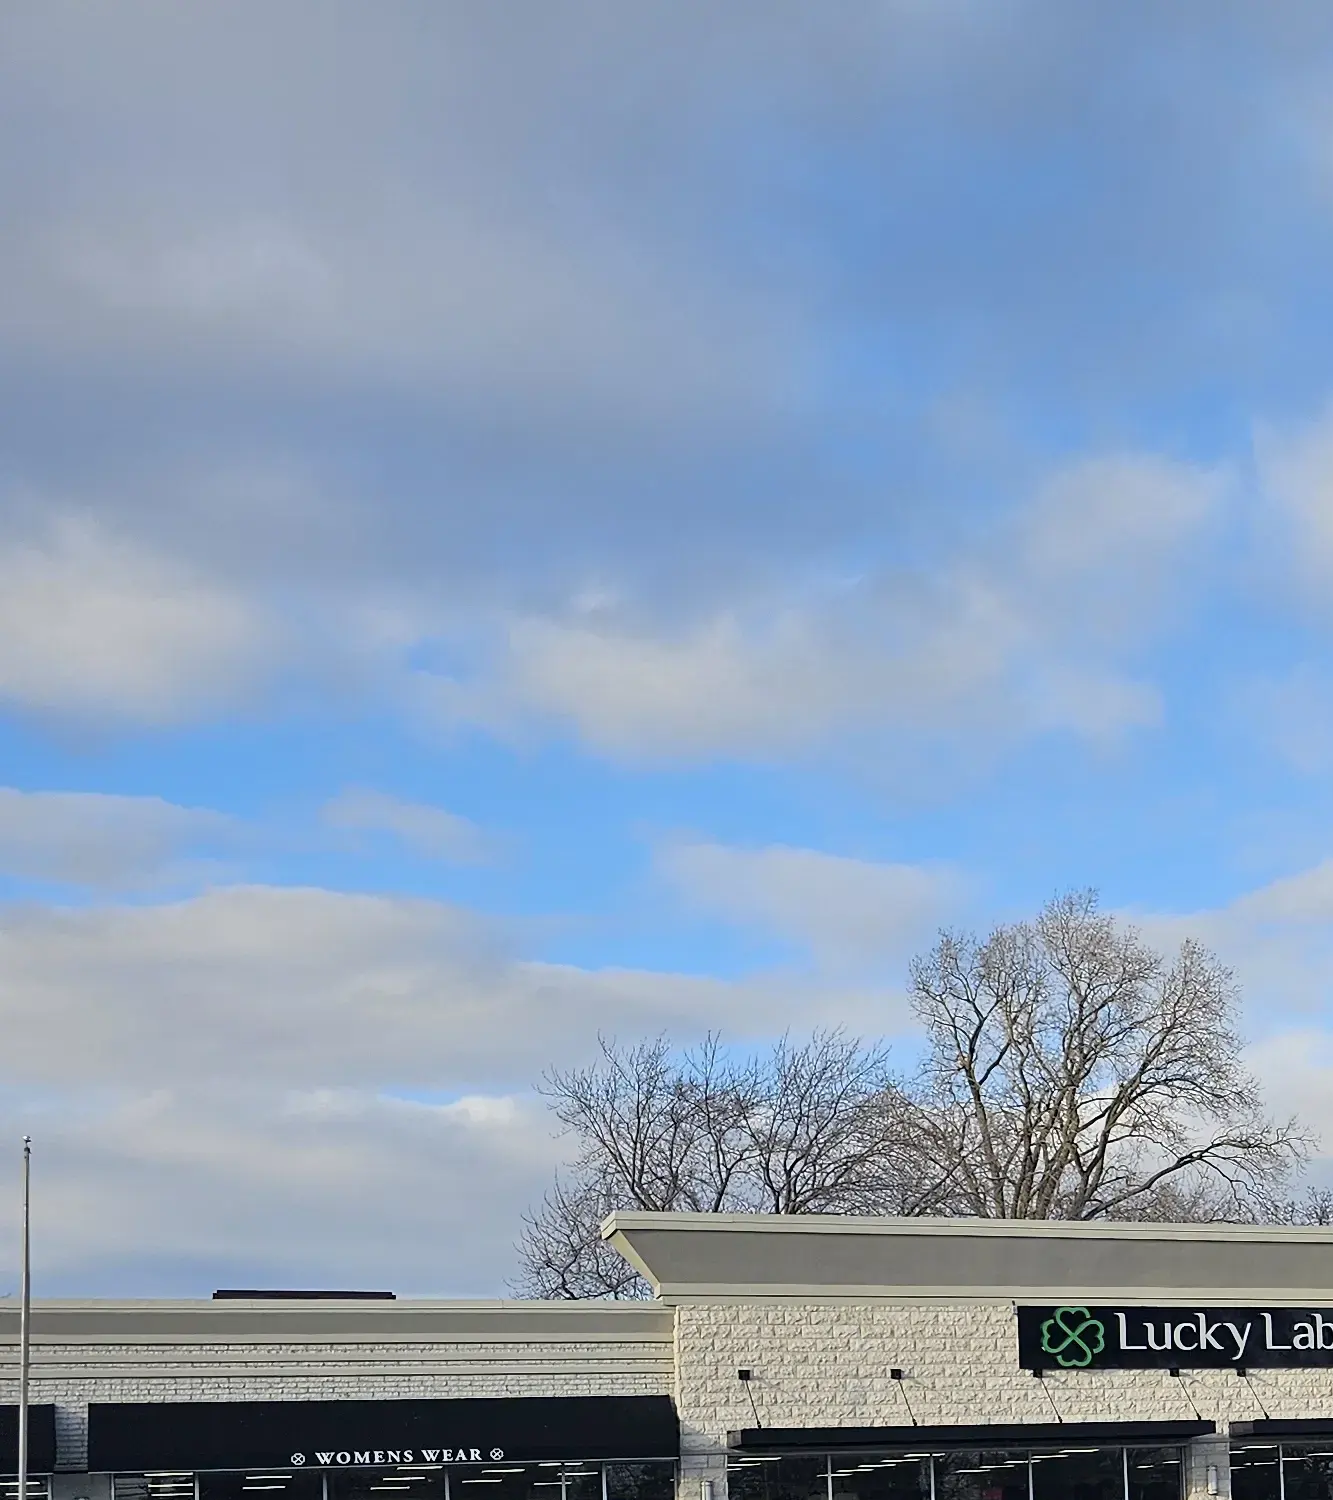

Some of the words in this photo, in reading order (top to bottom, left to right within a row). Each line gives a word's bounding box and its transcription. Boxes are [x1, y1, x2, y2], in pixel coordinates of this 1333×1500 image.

[1113, 1312, 1252, 1361] Lucky
[315, 1450, 414, 1465] WOMENS
[421, 1448, 482, 1462] WEAR
